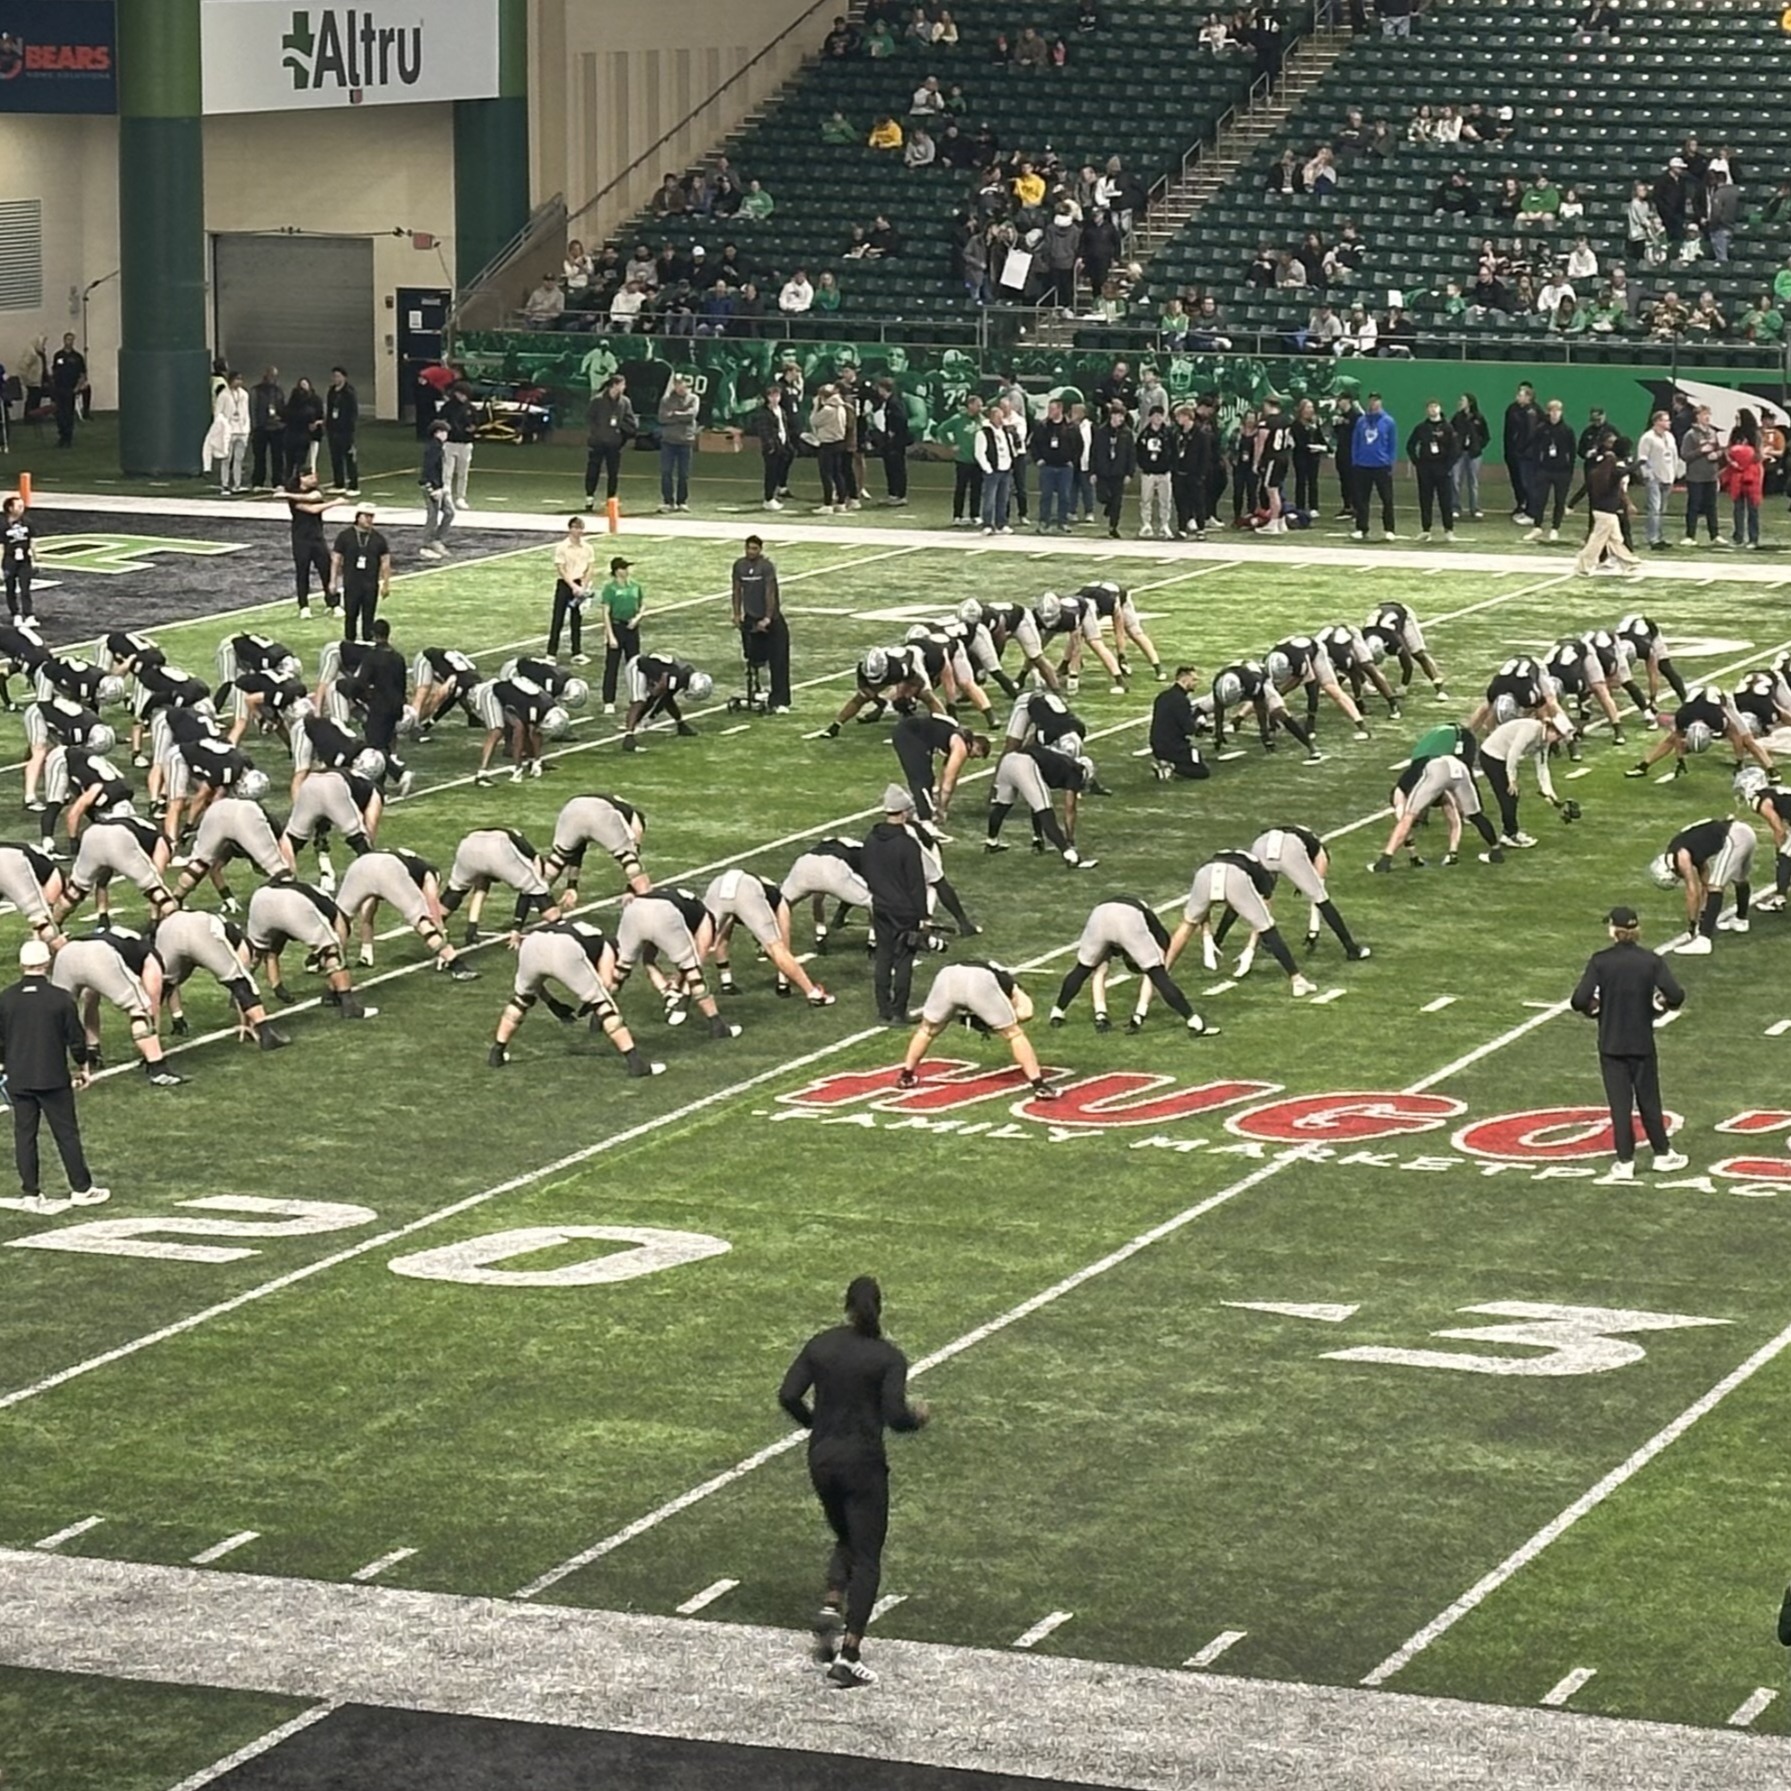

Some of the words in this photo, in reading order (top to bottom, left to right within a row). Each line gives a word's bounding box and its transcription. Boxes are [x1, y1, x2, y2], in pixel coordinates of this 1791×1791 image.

[25, 45, 111, 70] BEARS
[313, 9, 422, 89] Altru
[769, 1107, 1104, 1143] FAMILY
